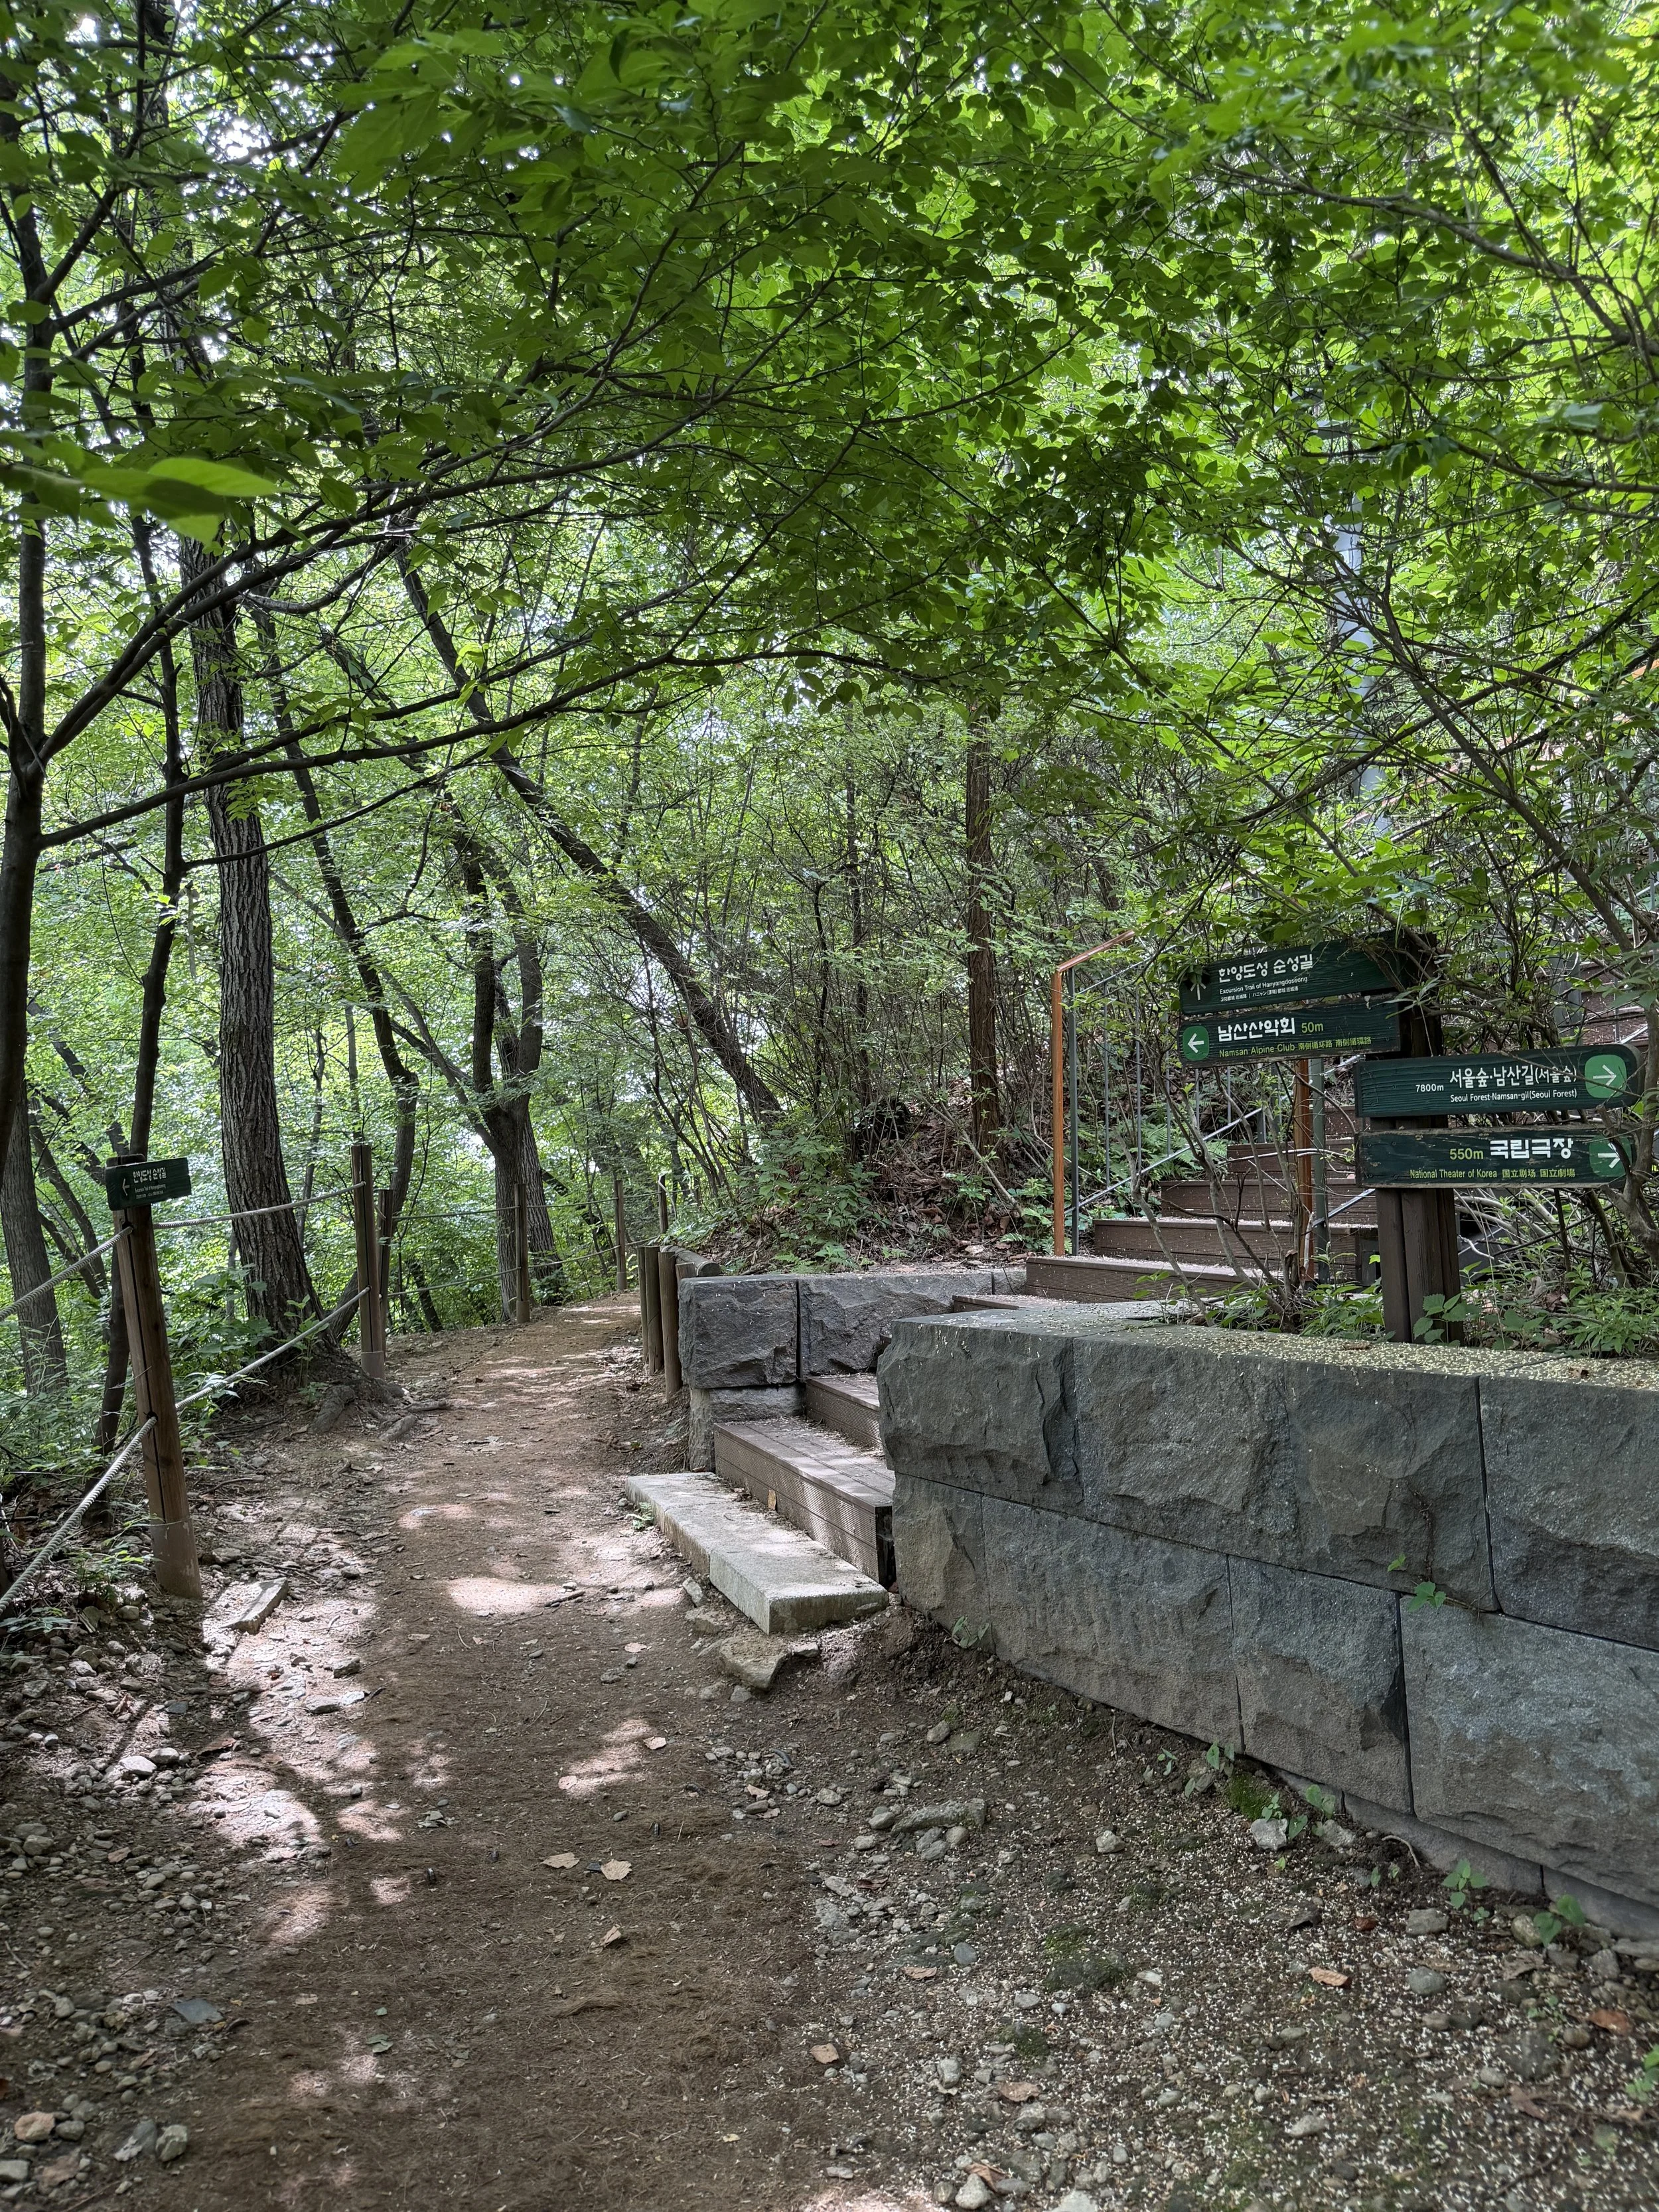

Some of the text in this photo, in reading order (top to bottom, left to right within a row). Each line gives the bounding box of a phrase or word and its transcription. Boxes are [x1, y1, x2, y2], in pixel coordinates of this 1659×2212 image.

[1218, 954, 1313, 983] 한양도성 순성길
[1219, 986, 1244, 995] Excursion
[1262, 977, 1308, 988] Hanyangdoseong
[1218, 1017, 1324, 1042] 남산산악회 50m
[1219, 1043, 1295, 1057] Namsan Alpine Club
[1415, 1083, 1444, 1093] 7800m
[1450, 1094, 1468, 1102] Seoul
[1553, 1088, 1577, 1098] Forest)
[1449, 1138, 1573, 1160] 550m 국립극장
[1410, 1169, 1497, 1179] National Theater of Korea
